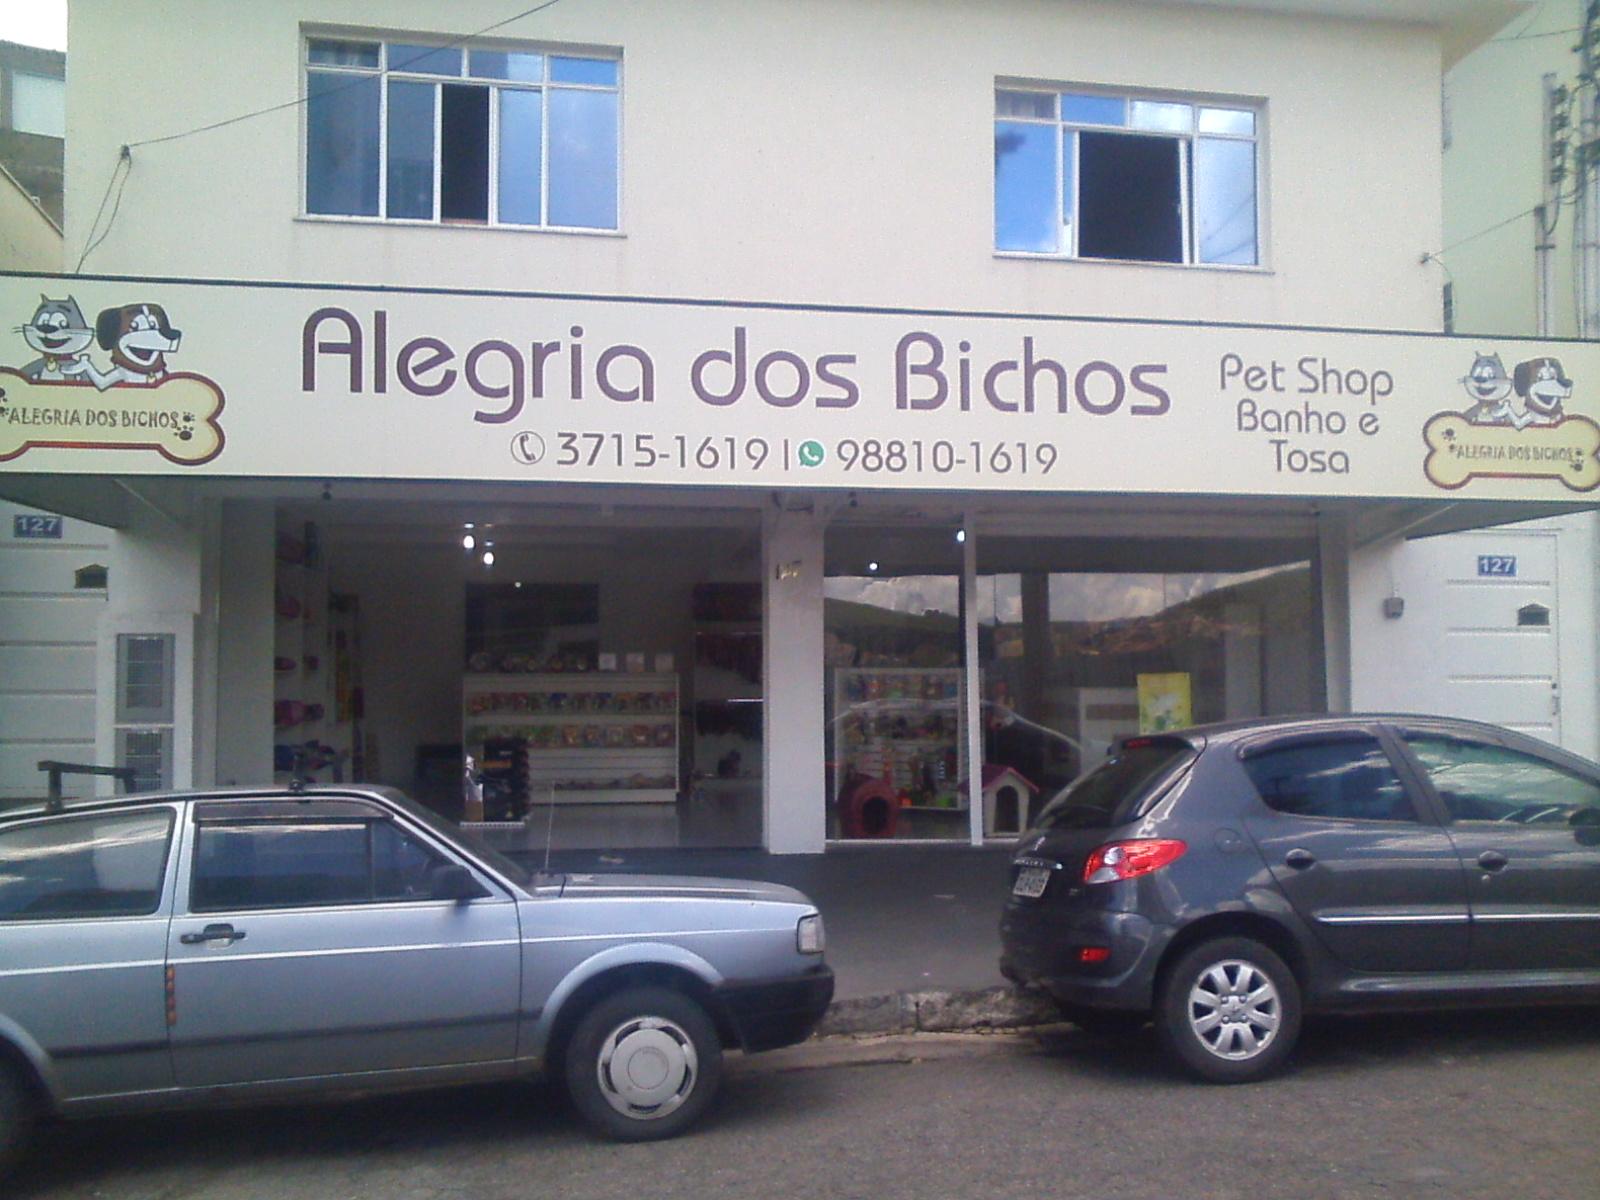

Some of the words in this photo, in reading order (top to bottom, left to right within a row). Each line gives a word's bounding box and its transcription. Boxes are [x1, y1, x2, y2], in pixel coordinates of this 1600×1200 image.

[302, 307, 654, 424] Alegria
[691, 327, 859, 408] dos
[895, 332, 1170, 416] Bichos
[1220, 353, 1286, 392] Pet
[1297, 357, 1393, 406] Shop
[8, 407, 81, 426] ALEGRIA
[85, 409, 117, 428] DOS
[121, 410, 179, 429] BICHOS
[1236, 398, 1346, 434] Banho
[1358, 412, 1380, 436] e
[556, 432, 769, 471] 3715-1619
[836, 439, 1058, 475] 98810-1619
[1269, 439, 1350, 474] Tosa
[1456, 445, 1505, 460] ALEGRIA
[1508, 446, 1530, 461] DOS
[18, 515, 59, 532] 127
[1480, 558, 1514, 573] 127
